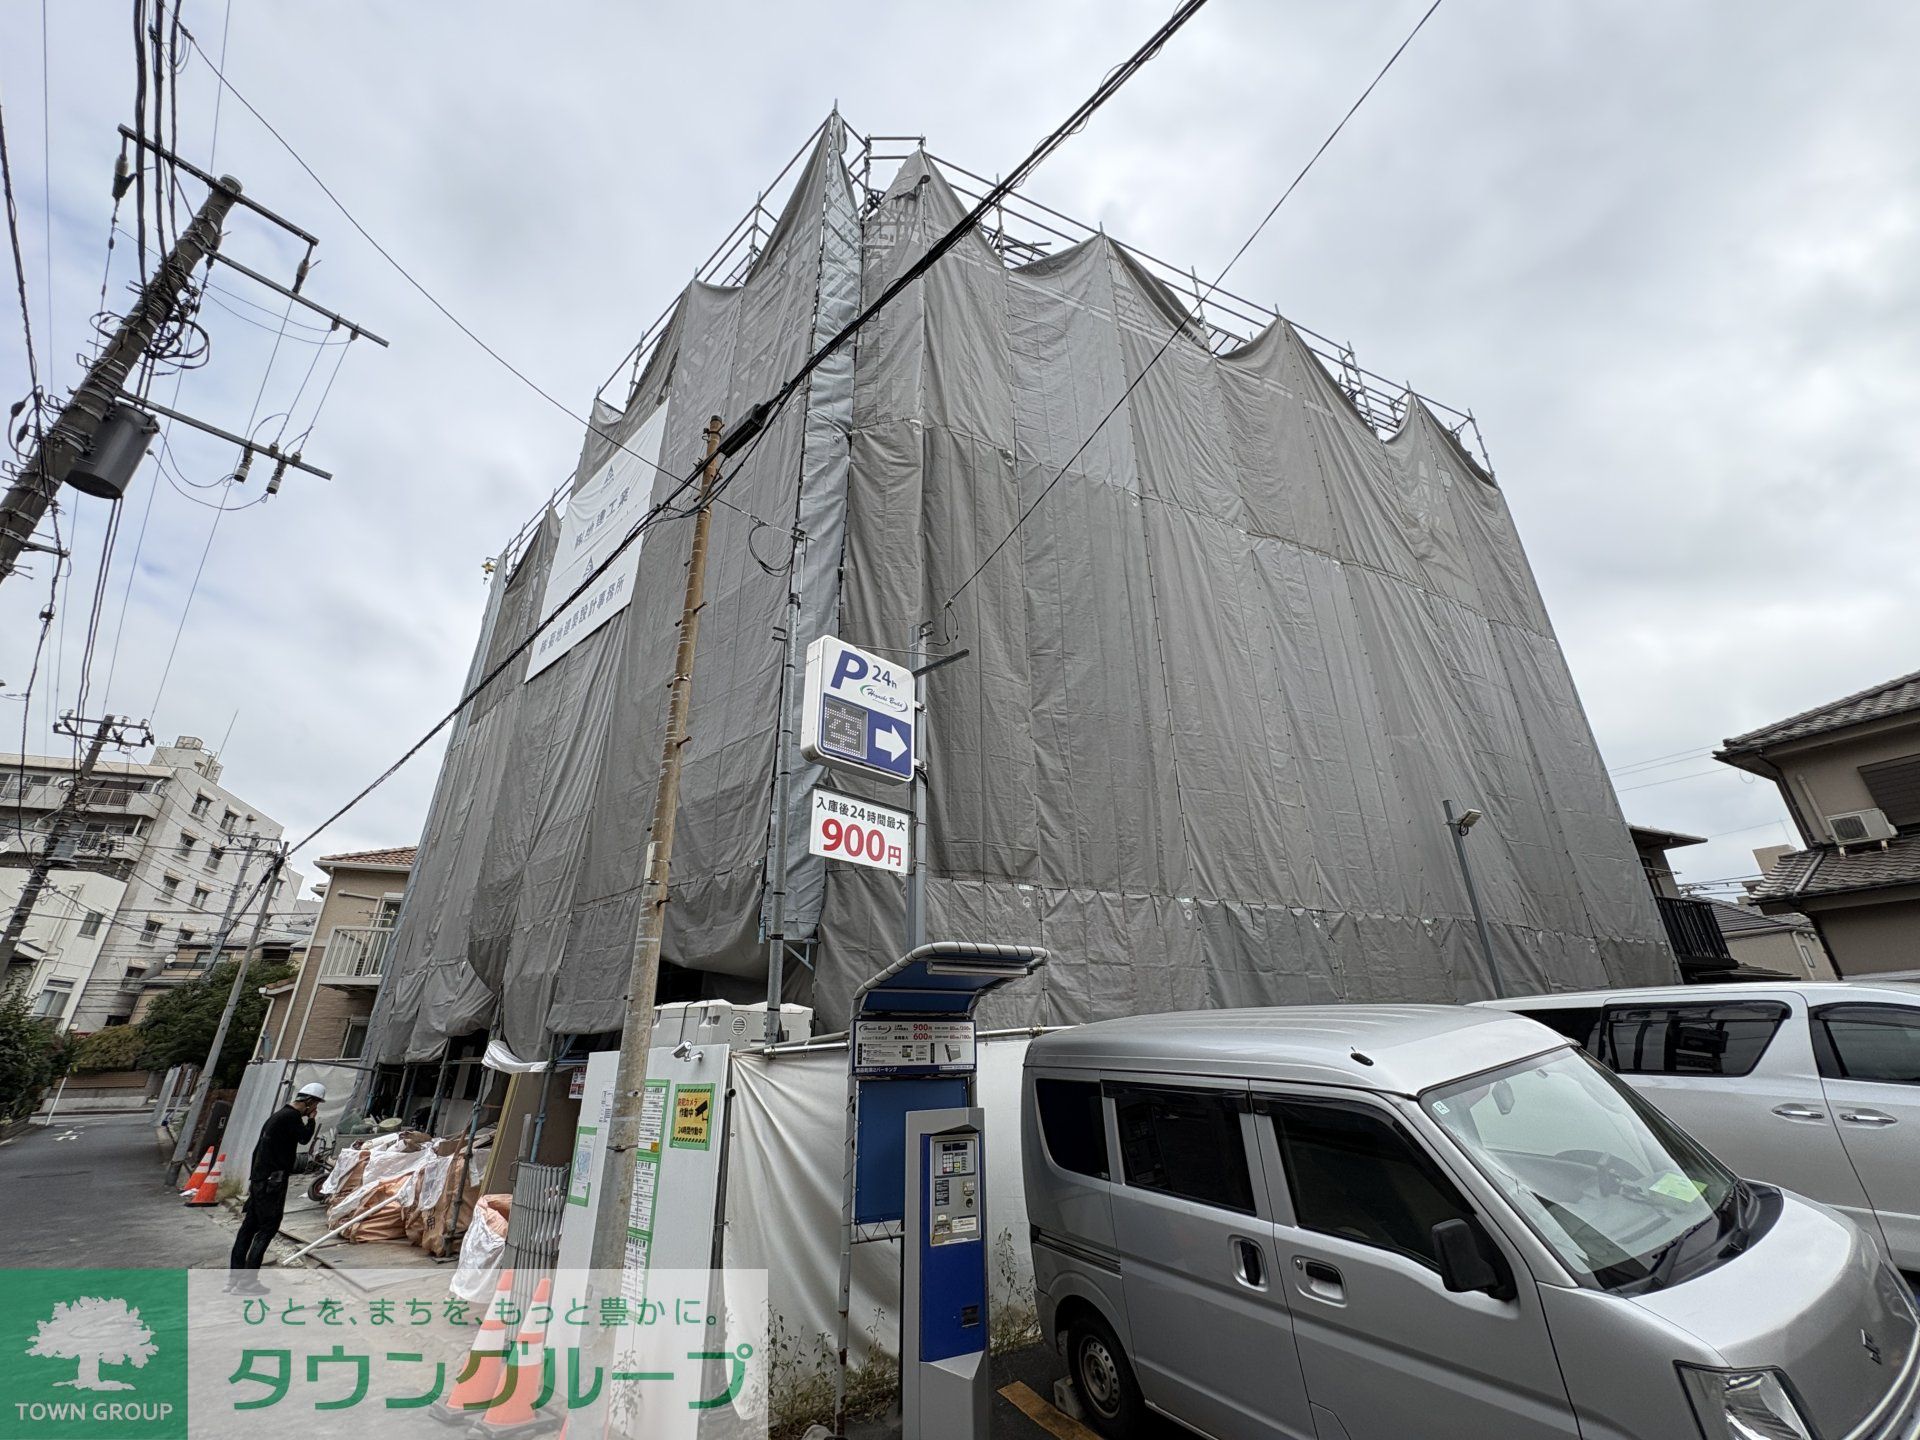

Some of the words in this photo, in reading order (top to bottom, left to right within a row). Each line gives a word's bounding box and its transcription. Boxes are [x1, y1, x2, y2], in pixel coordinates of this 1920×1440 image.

[830, 649, 868, 690] P
[872, 664, 897, 689] 24h
[816, 796, 906, 832] 入庫後24時間最大
[821, 818, 902, 867] 900円
